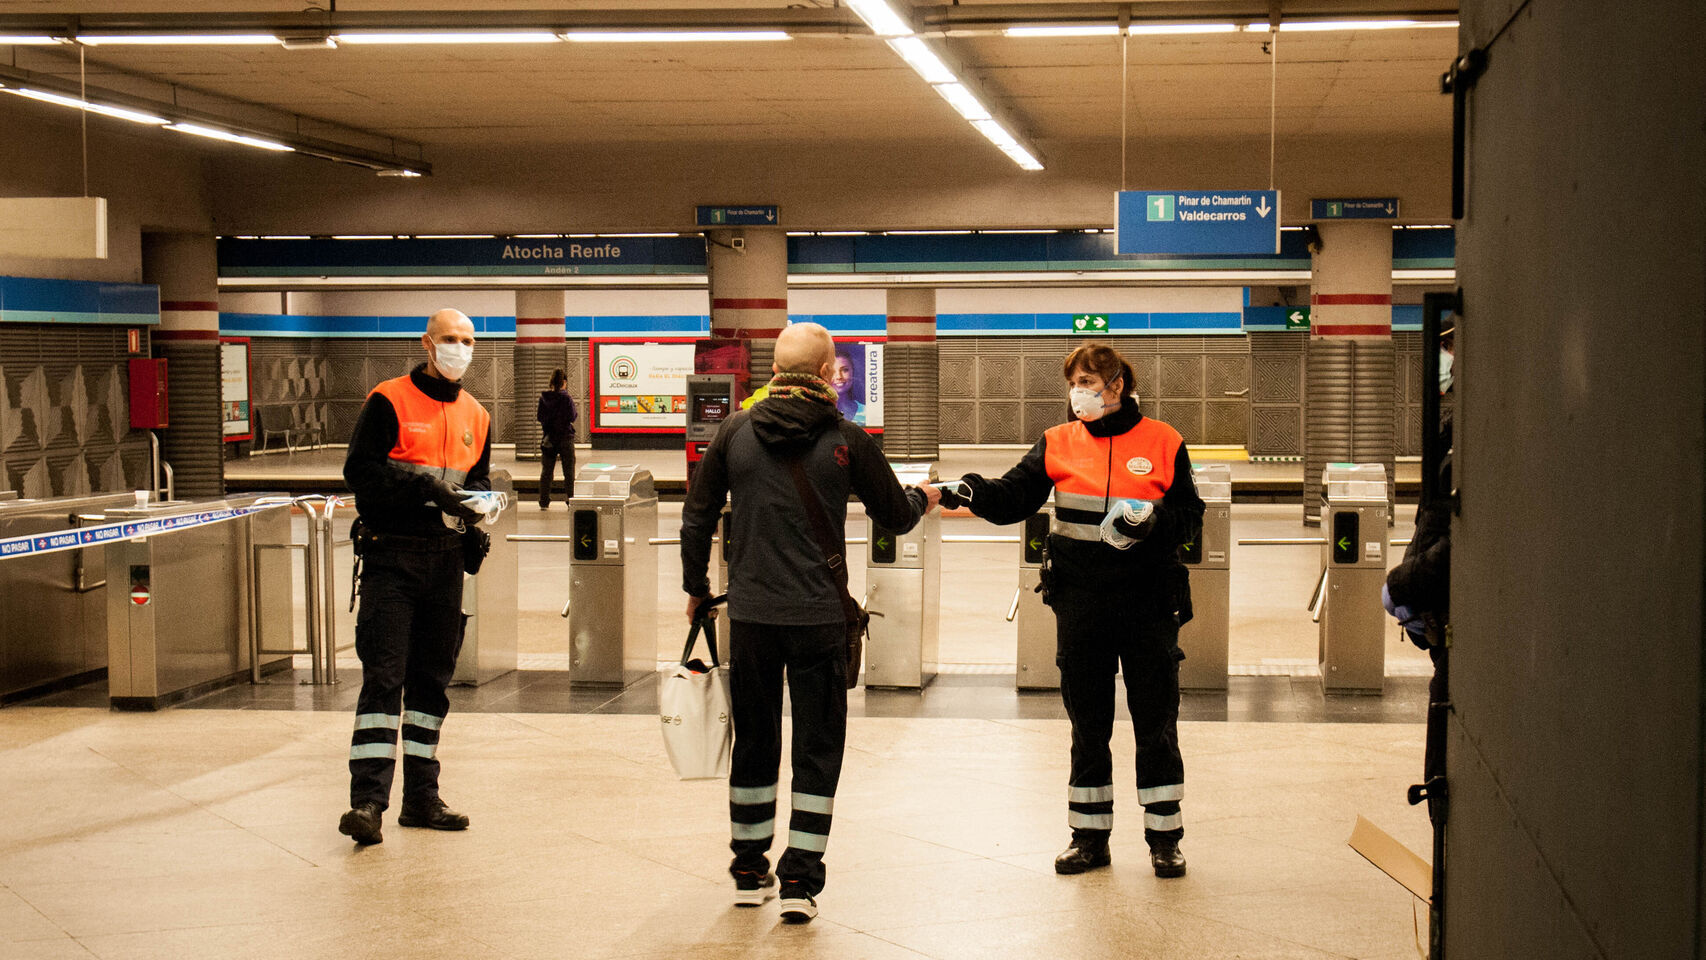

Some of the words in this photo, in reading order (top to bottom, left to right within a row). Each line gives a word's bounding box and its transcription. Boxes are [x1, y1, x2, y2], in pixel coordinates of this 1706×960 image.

[1154, 198, 1165, 219] 1
[1178, 196, 1199, 206] Pinar
[1200, 196, 1211, 206] de
[1212, 195, 1252, 206] Chamartín
[1178, 210, 1247, 221] Valdecarros
[502, 244, 564, 259] Atocha
[570, 243, 621, 258] Renfe
[544, 266, 572, 274] Andén
[574, 266, 579, 274] 2
[869, 350, 878, 403] creatura
[1, 543, 11, 554] NO
[11, 541, 30, 553] PASAR
[50, 537, 58, 547] NO
[59, 535, 77, 546] PASAR
[95, 530, 103, 540] NO
[103, 527, 120, 538] PASAR
